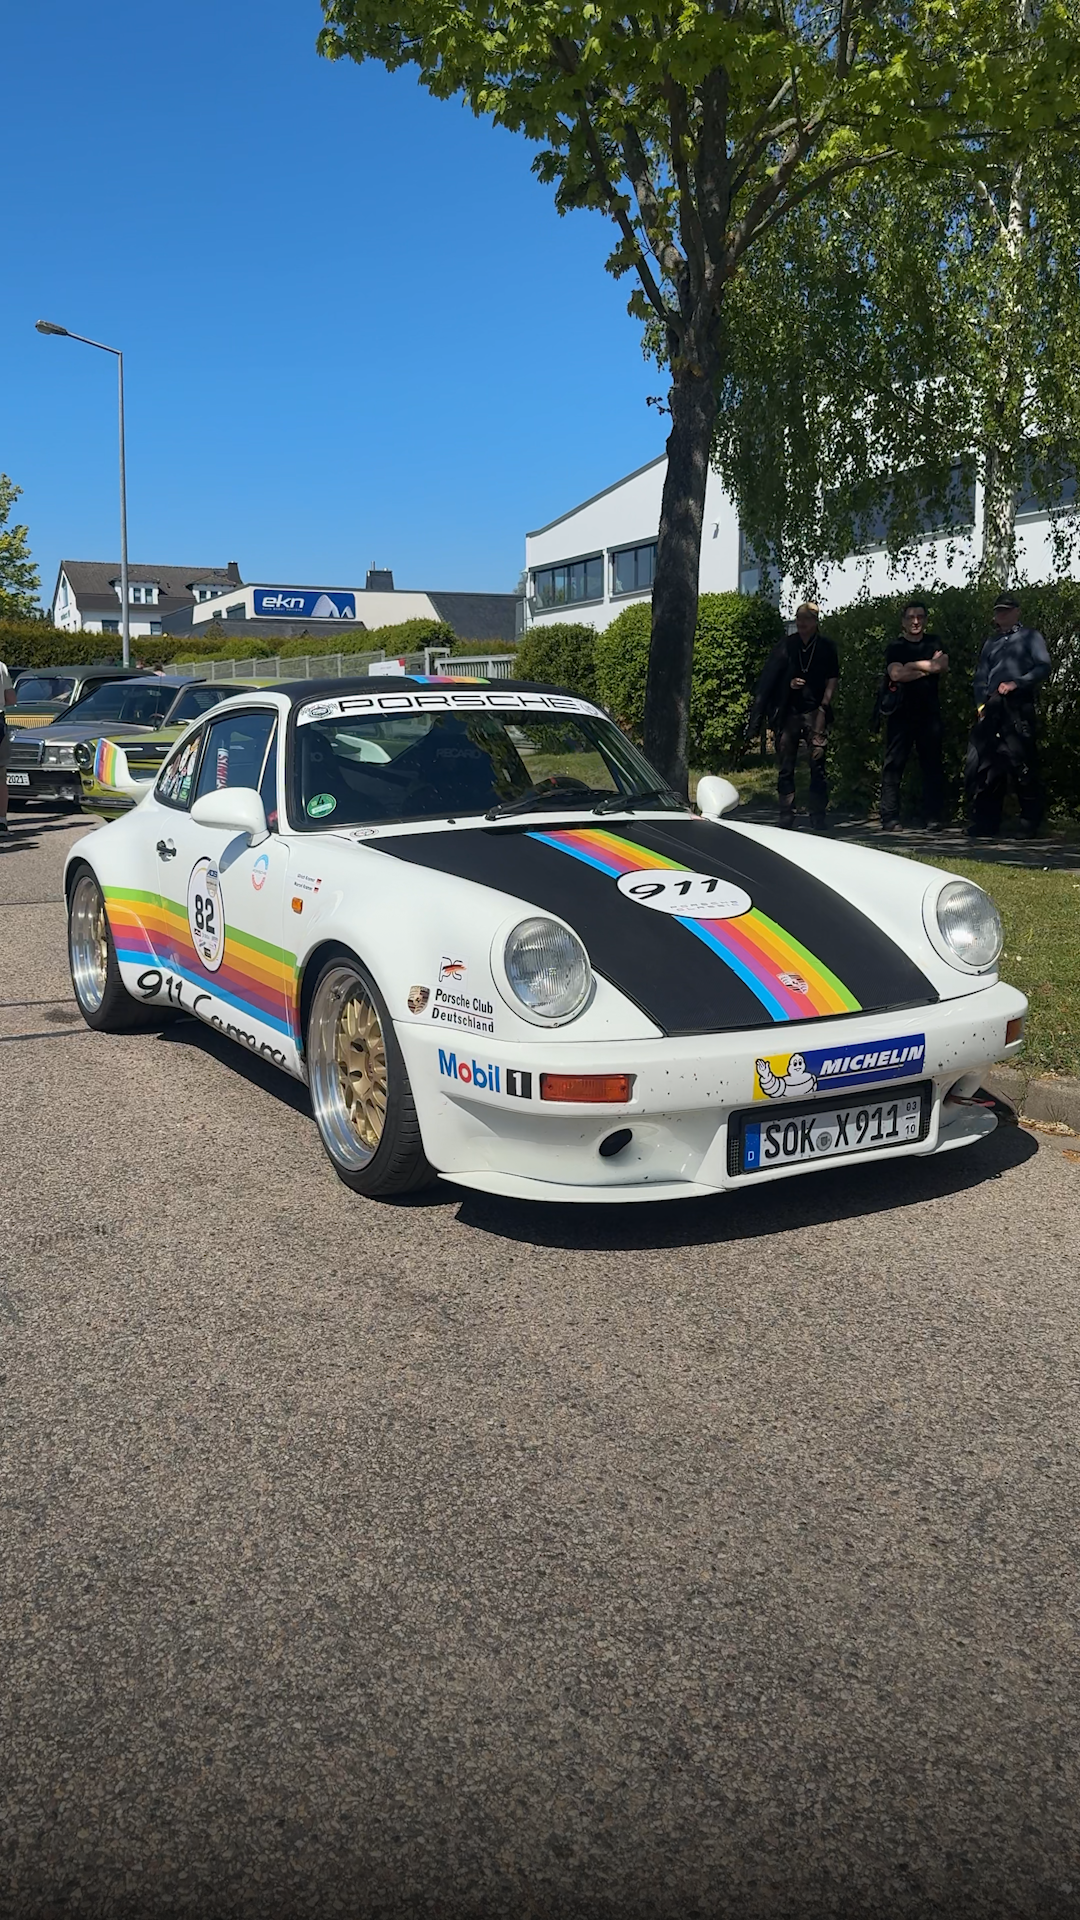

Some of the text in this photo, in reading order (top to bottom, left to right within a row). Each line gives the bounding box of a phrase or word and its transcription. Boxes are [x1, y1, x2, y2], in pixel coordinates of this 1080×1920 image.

[262, 594, 305, 608] ekn
[339, 694, 581, 713] PORSCHE
[436, 747, 482, 760] RECARO
[8, 775, 24, 784] 2021
[316, 796, 325, 806] 4
[629, 878, 719, 900] 911
[195, 894, 215, 935] 82
[137, 969, 183, 1007] 911
[435, 988, 494, 1015] Porsche Club
[431, 1007, 495, 1034] Deutschland
[819, 1044, 925, 1076] MICHELIN
[438, 1047, 524, 1098] Mobil 1
[906, 1102, 917, 1112] 03
[764, 1117, 817, 1159] SOK
[905, 1123, 916, 1134] 10
[747, 1150, 755, 1162] D
